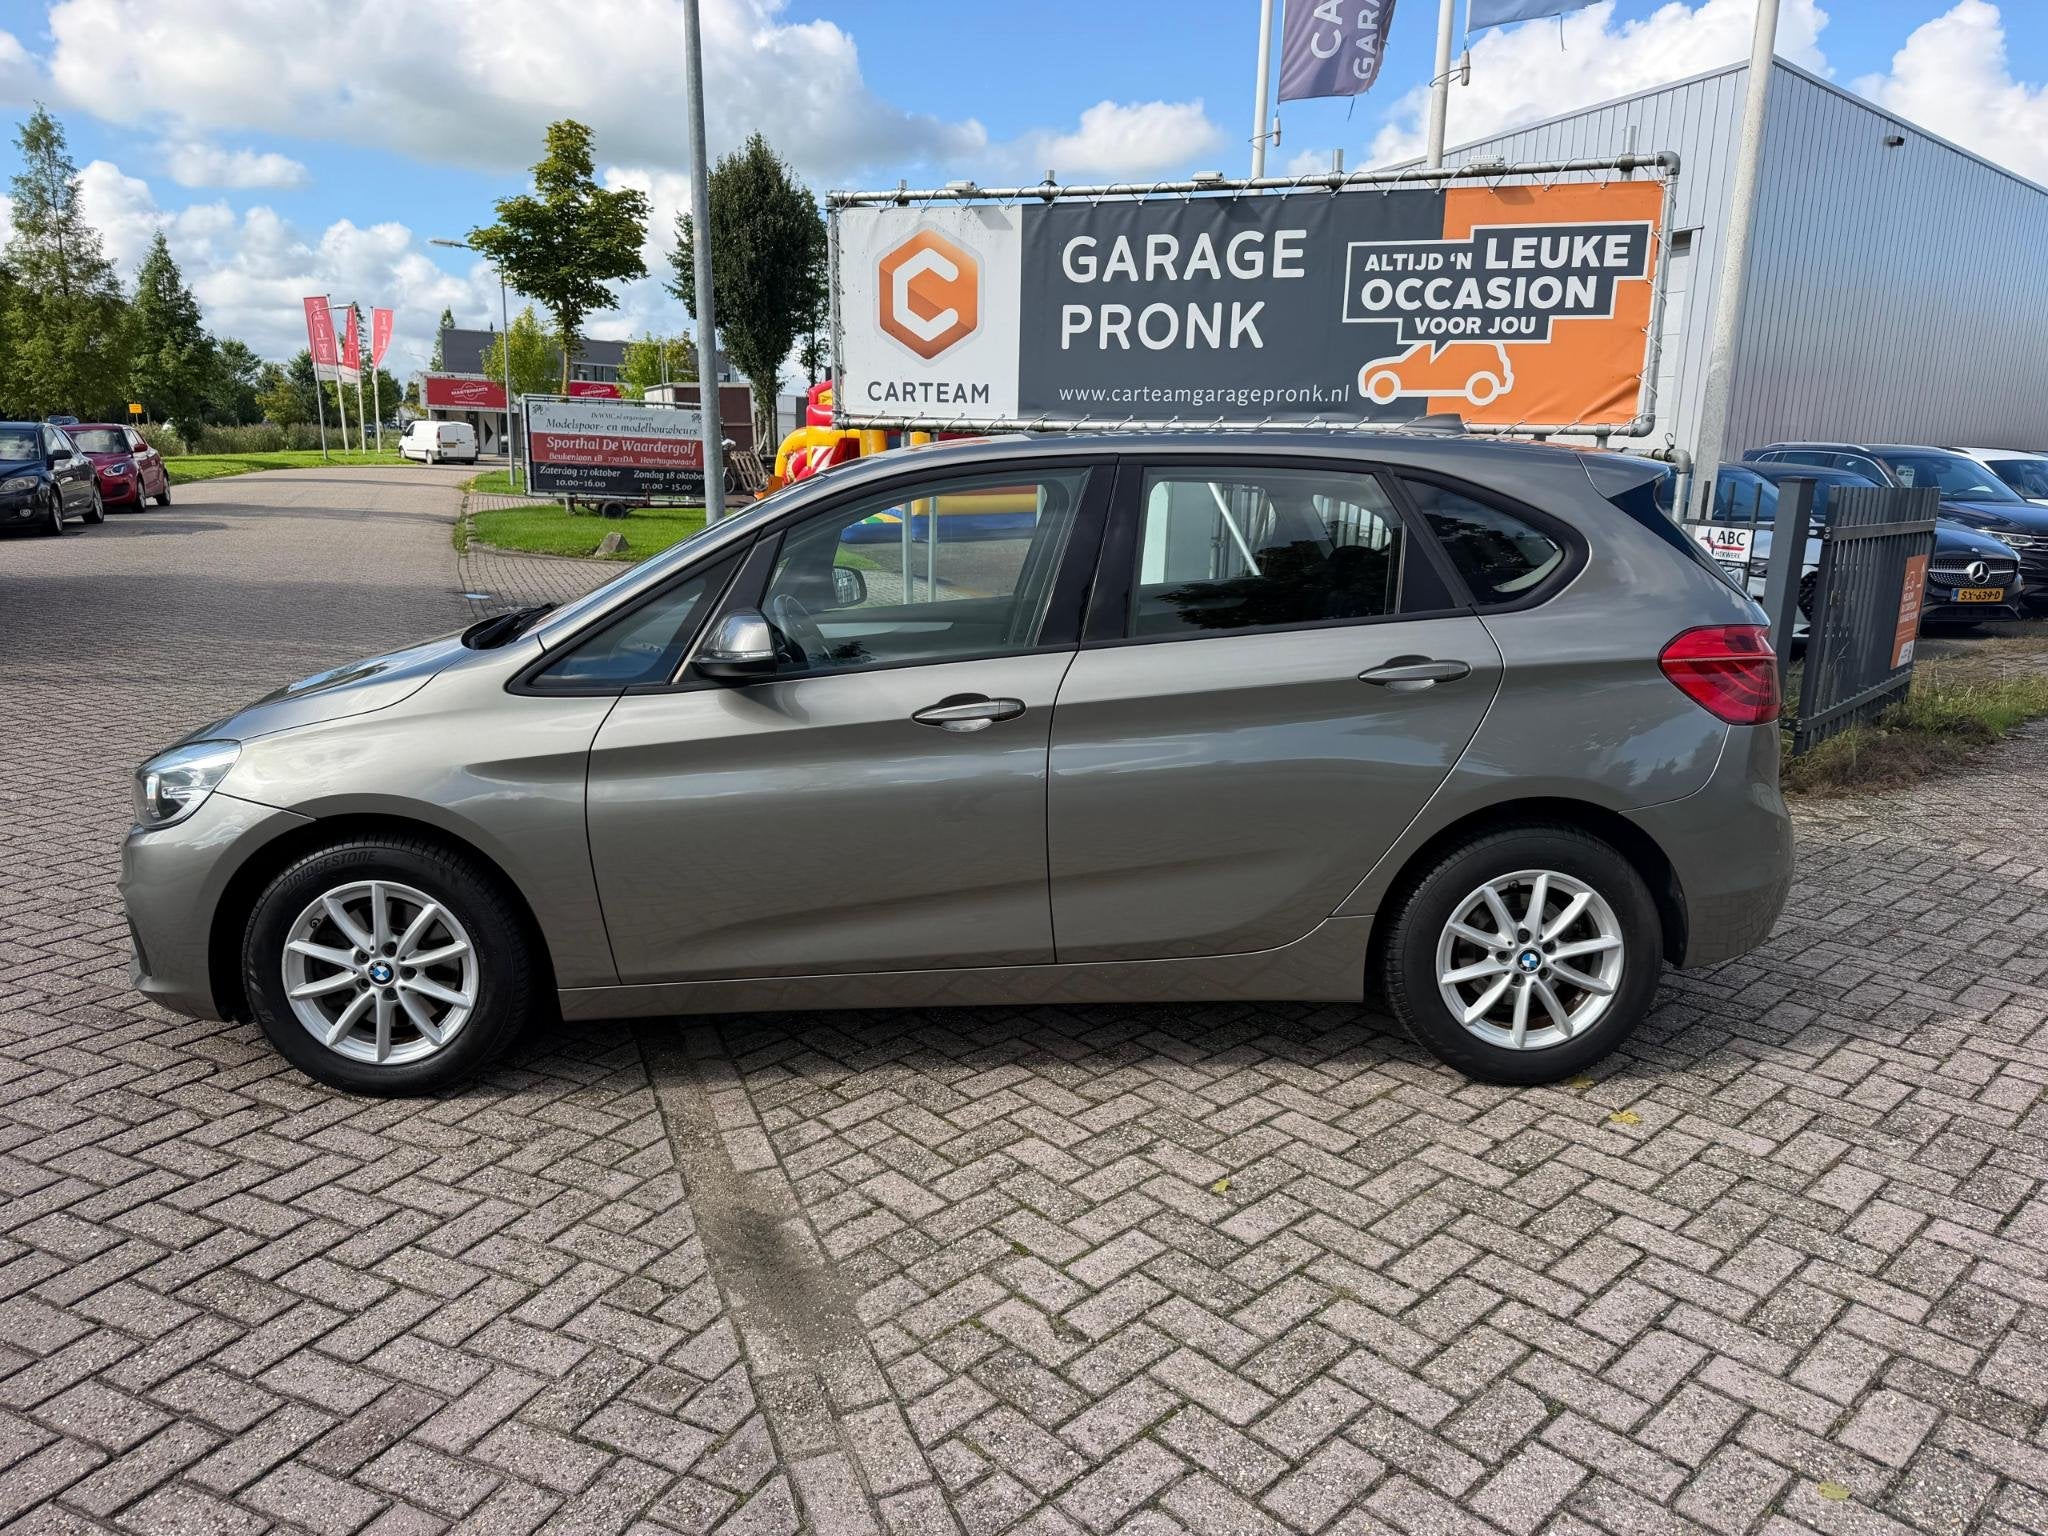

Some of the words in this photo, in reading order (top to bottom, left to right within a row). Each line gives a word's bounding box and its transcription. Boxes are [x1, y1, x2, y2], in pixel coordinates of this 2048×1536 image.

[1062, 229, 1307, 283] GARAGE
[1364, 253, 1444, 272] ALTIJD
[1485, 234, 1632, 270] LEUKE
[1361, 275, 1598, 311] OCCASION
[1061, 301, 1265, 350] PRONK
[1415, 317, 1482, 335] VOOR
[1488, 316, 1536, 334] JOU
[867, 381, 990, 404] CARTEAM
[1059, 384, 1350, 406] www.carteamgaragepronk.nl
[546, 418, 604, 432] Modelspoor-
[621, 423, 698, 435] modelbouwbeurs
[546, 436, 599, 451] Sporthal
[603, 439, 619, 451] De
[621, 440, 696, 457] Waardergolf
[540, 466, 577, 477] Zaterdag
[589, 468, 621, 477] oktober
[633, 470, 664, 480] Zondag
[666, 472, 675, 480] 18
[1717, 531, 1746, 546] ABC
[1961, 590, 2002, 601] SX-639-D
